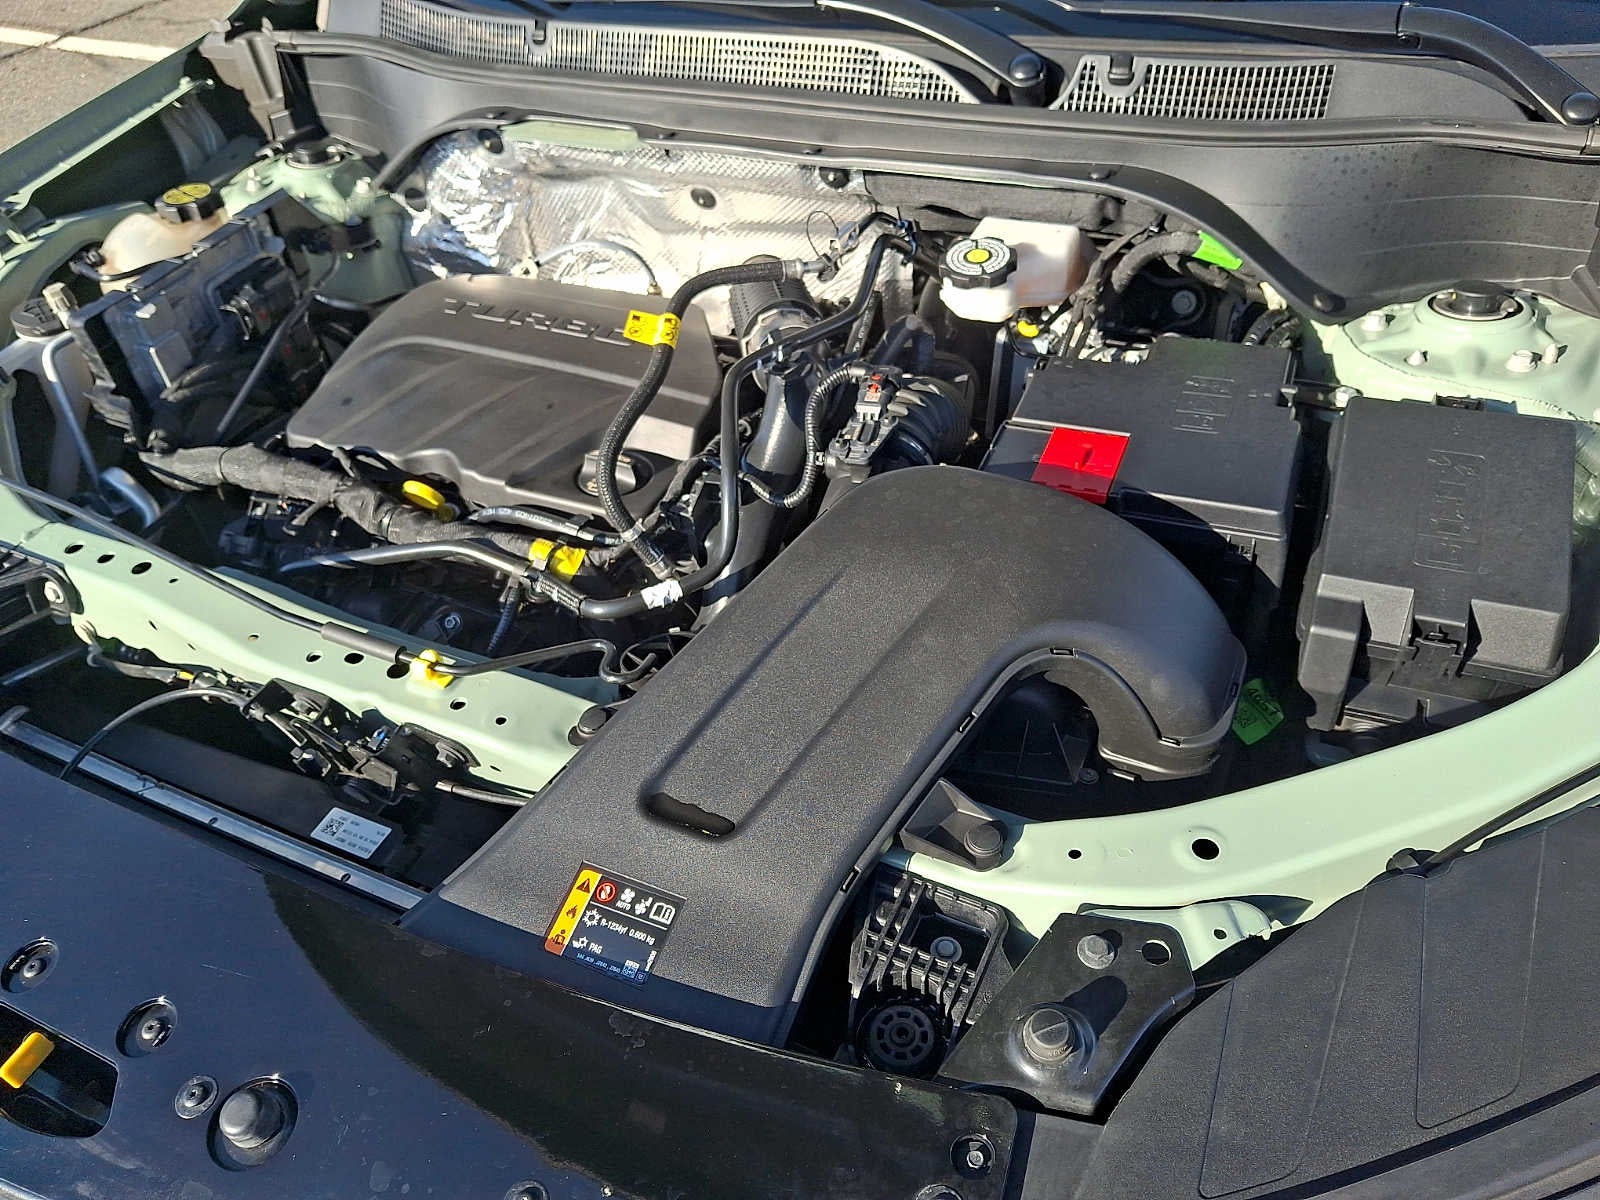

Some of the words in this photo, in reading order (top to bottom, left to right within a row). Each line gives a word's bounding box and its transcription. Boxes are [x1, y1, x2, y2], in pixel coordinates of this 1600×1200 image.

[616, 900, 632, 910] AUTO
[600, 918, 629, 936] R-1234yf
[645, 935, 656, 946] kg
[588, 943, 603, 954] PAG
